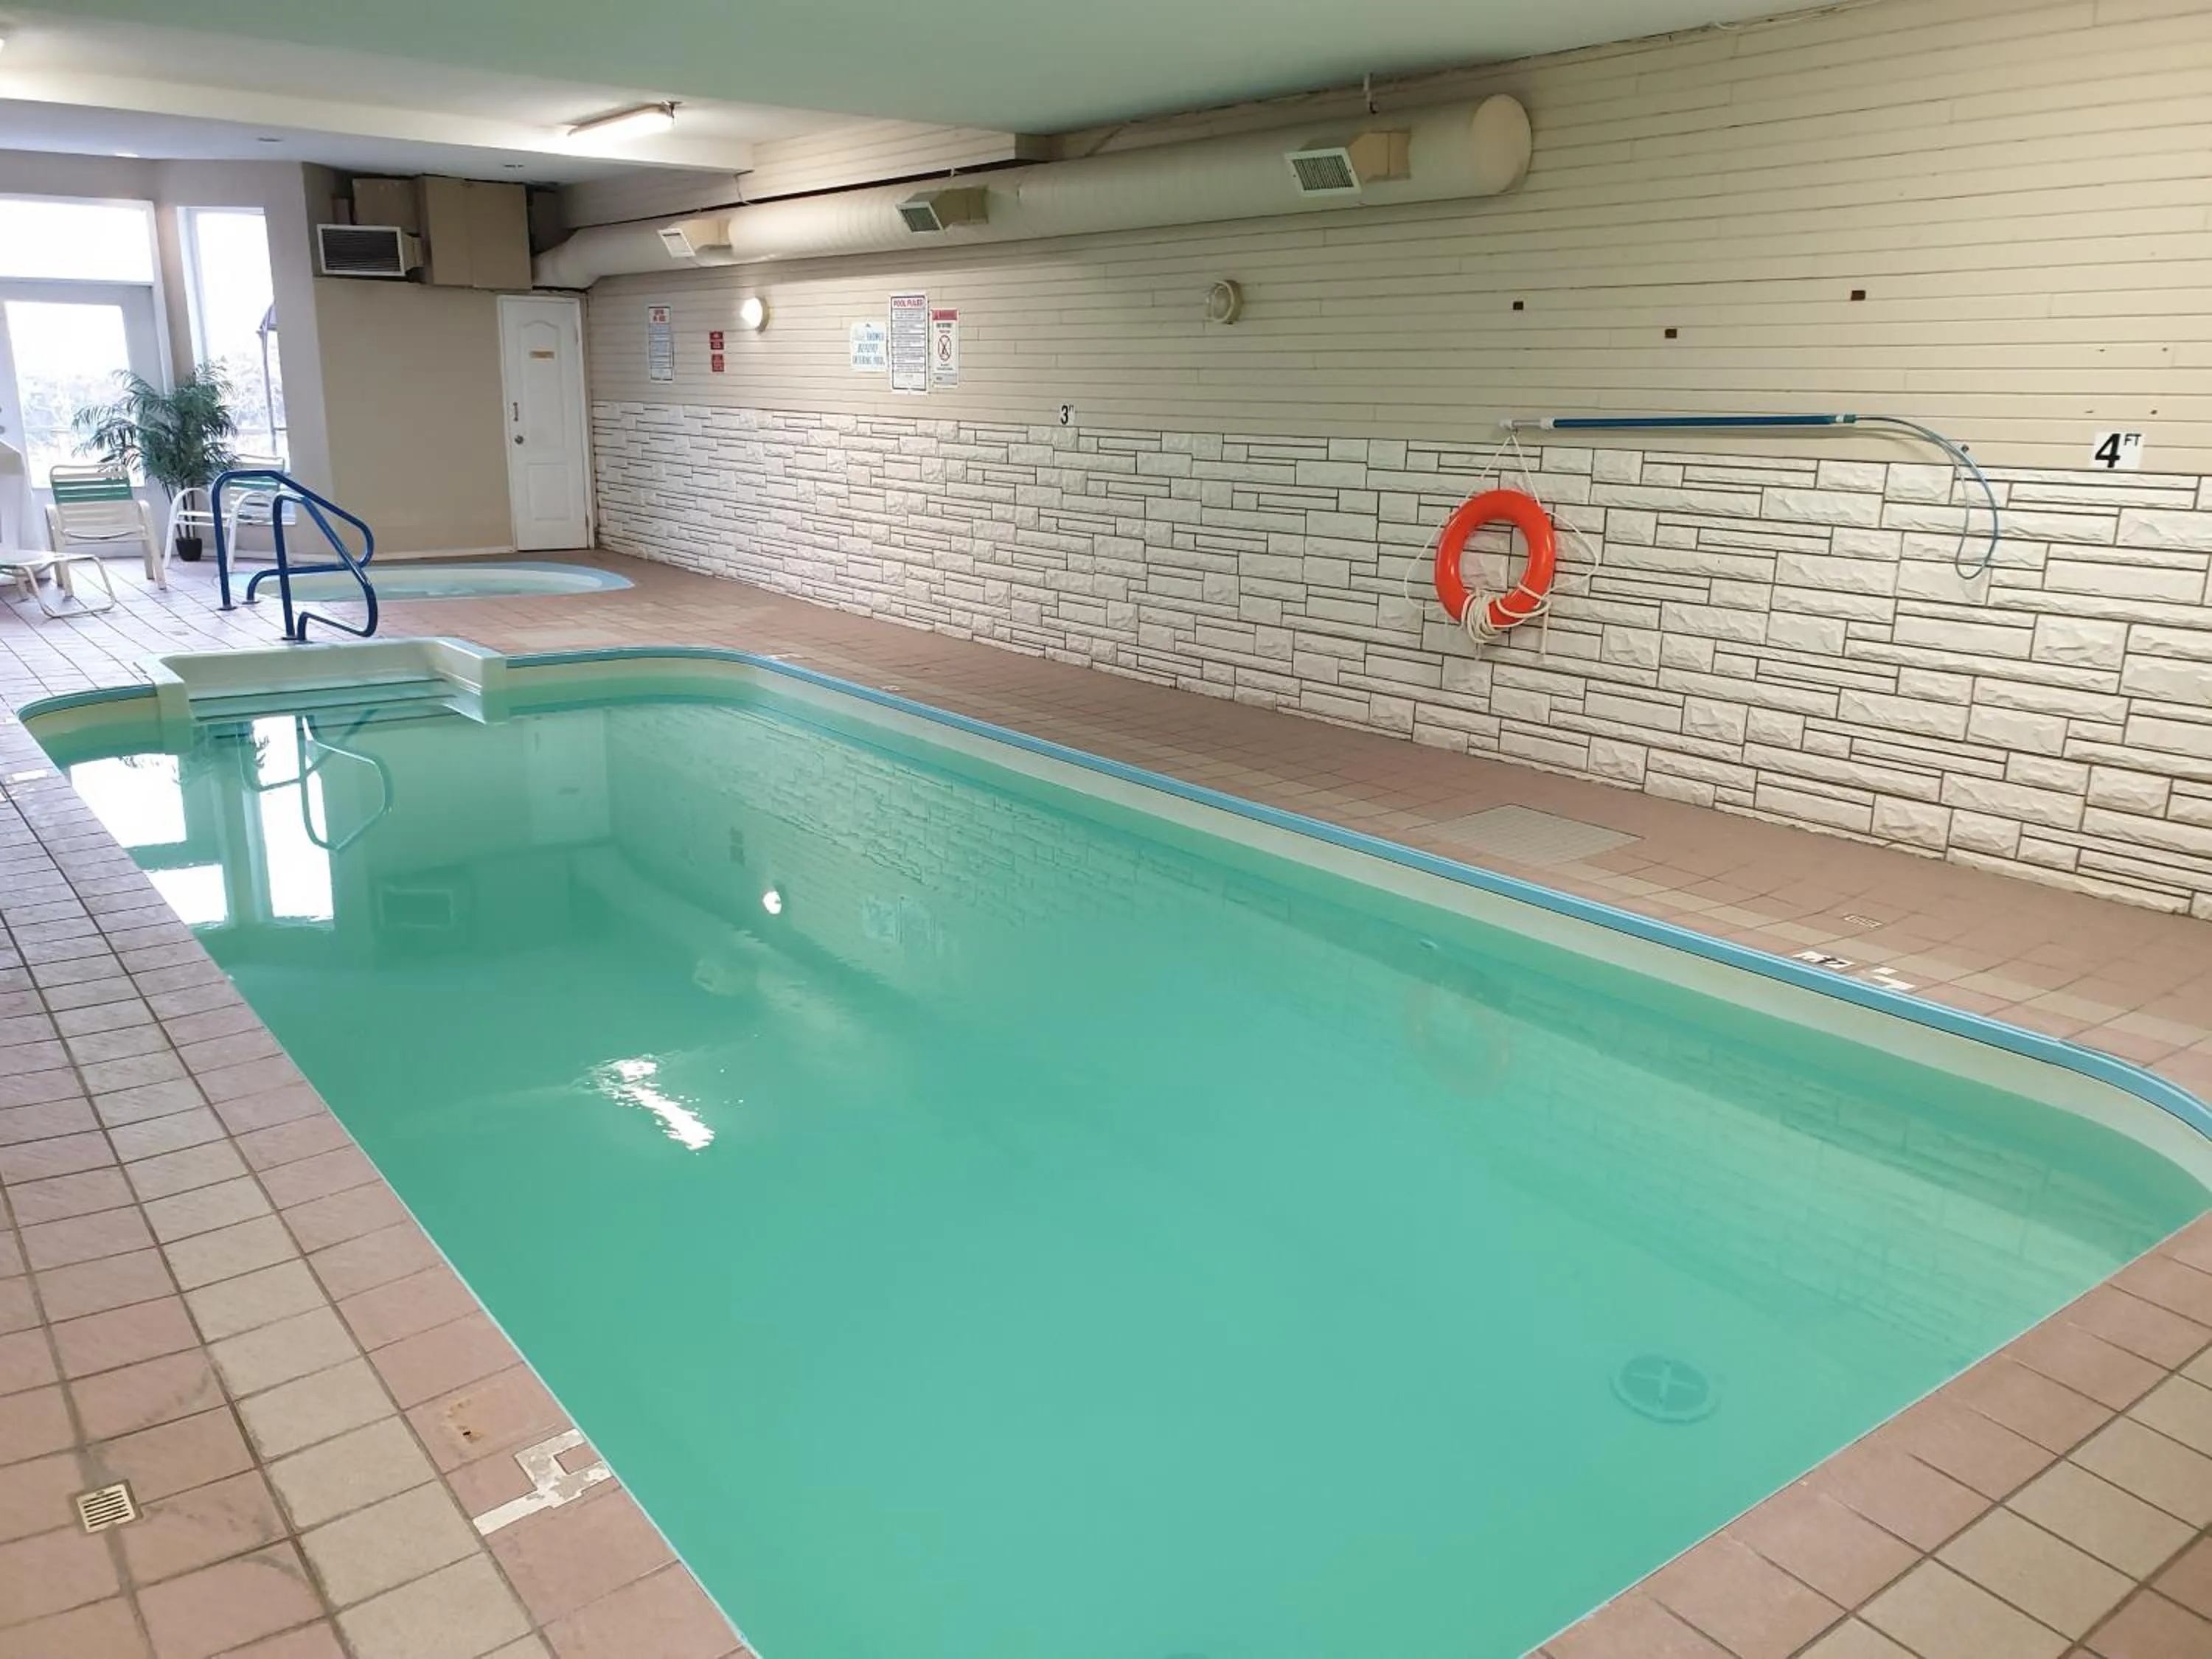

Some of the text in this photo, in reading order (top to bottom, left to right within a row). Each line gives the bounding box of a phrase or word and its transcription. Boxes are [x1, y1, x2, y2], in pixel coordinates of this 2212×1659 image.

[1060, 405, 1068, 425] 3
[2095, 433, 2142, 468] 4 FT
